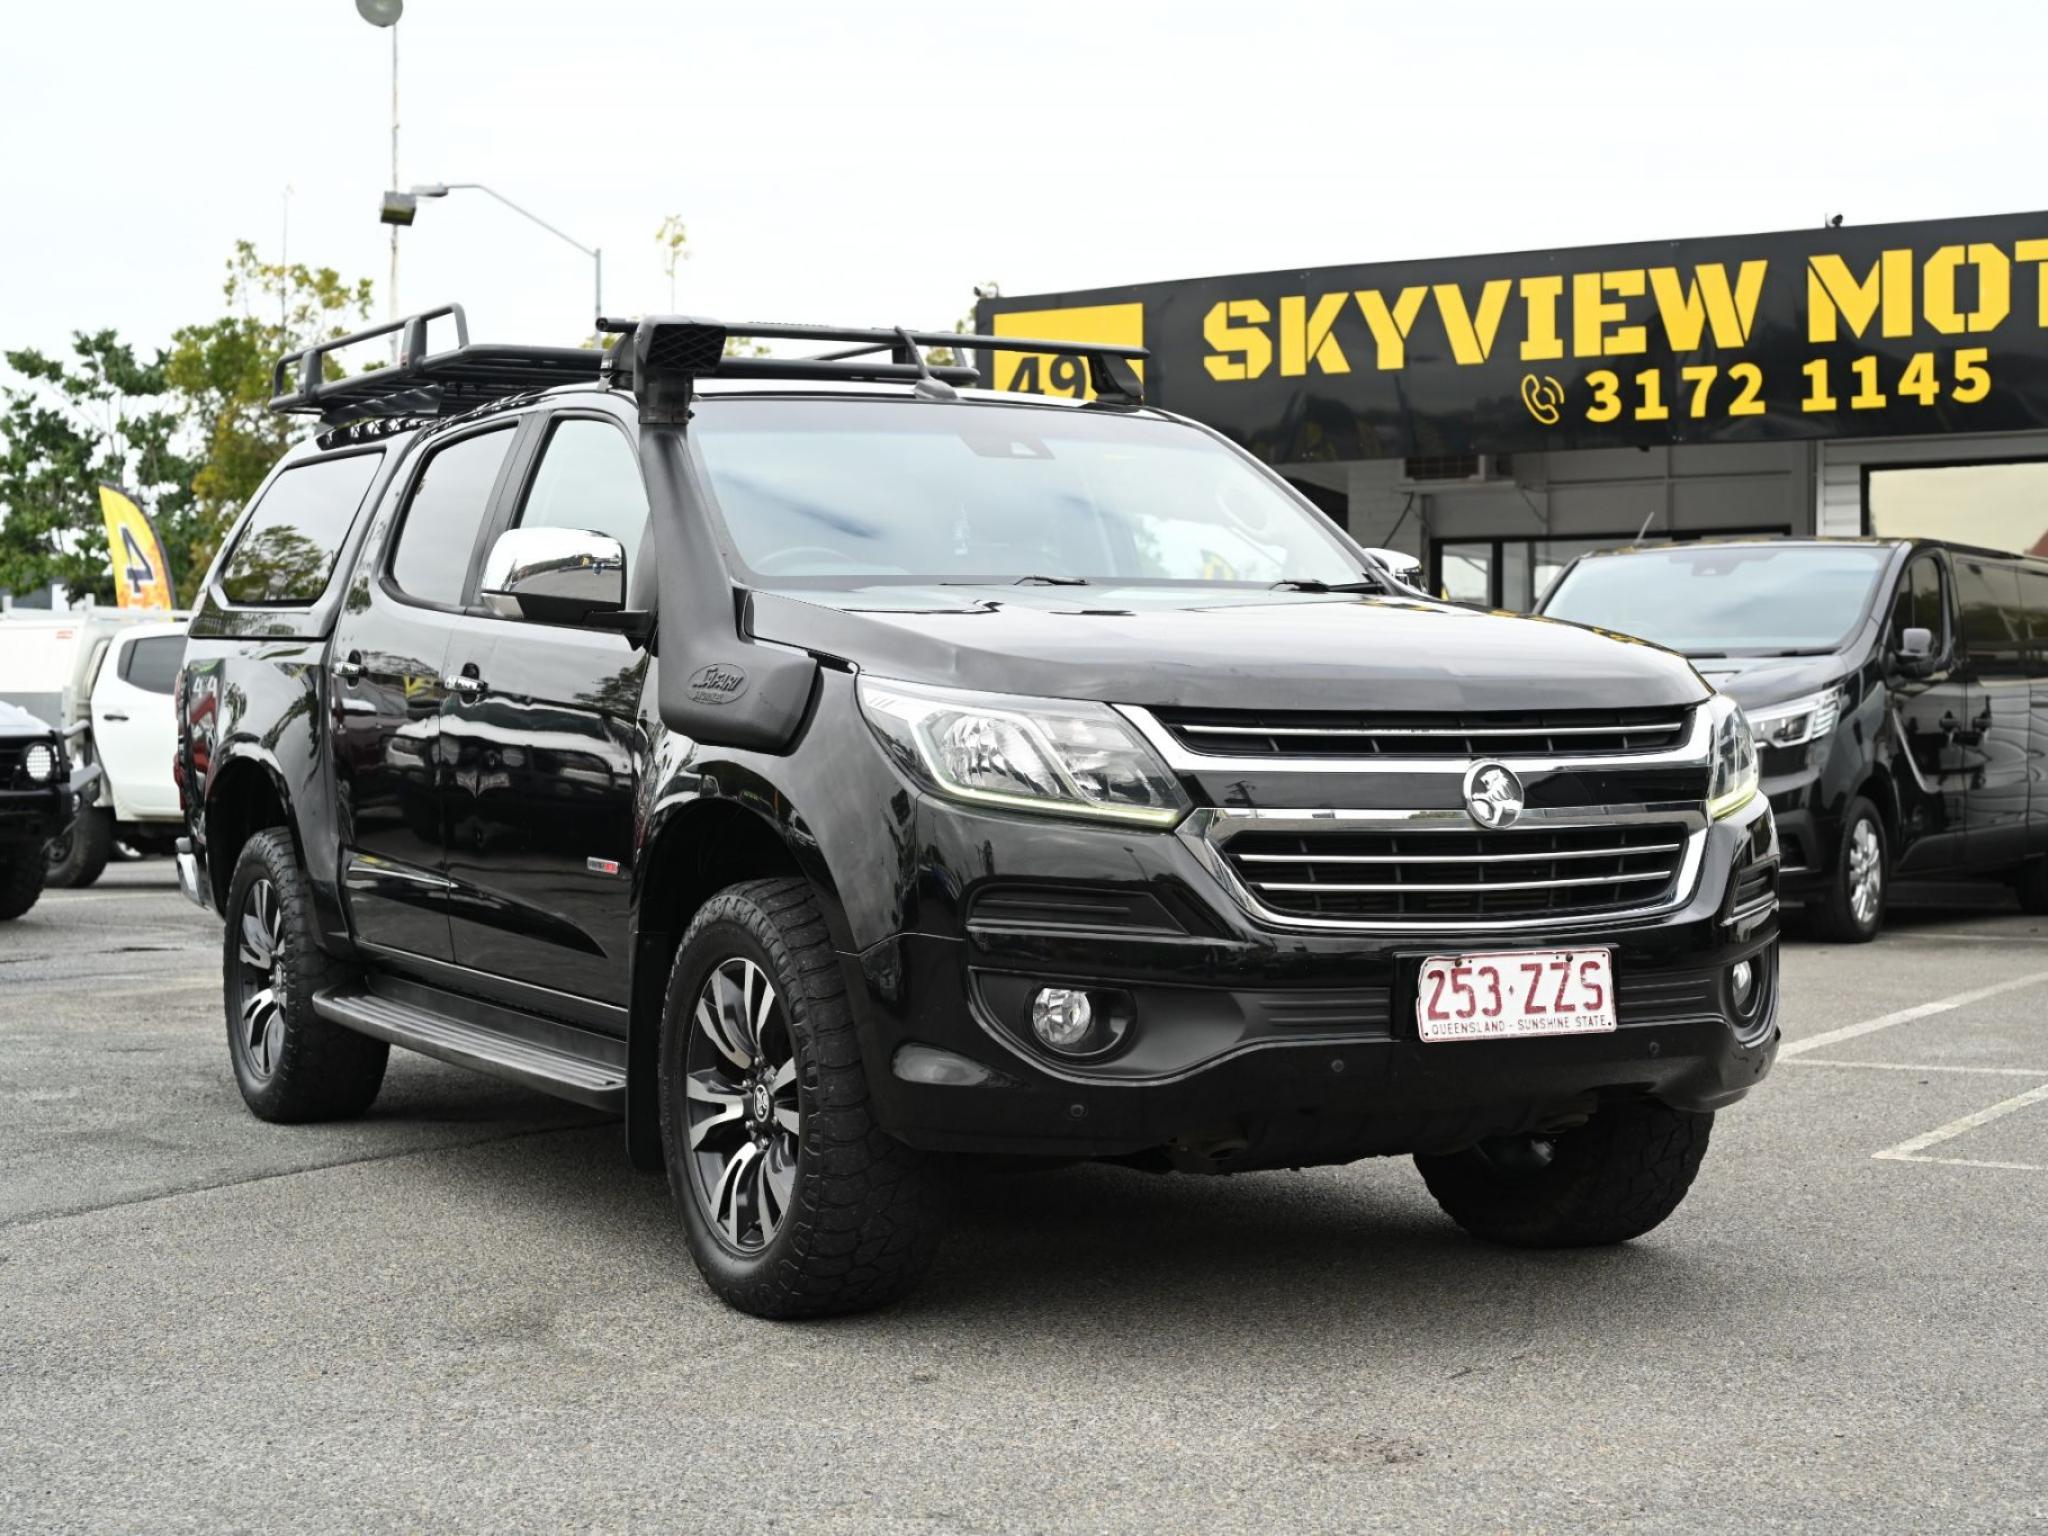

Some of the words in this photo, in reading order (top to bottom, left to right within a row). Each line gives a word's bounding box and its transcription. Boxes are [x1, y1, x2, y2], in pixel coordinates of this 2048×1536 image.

[1204, 260, 1767, 380] SKYVIEW
[1585, 363, 1766, 423] 3172
[1802, 348, 1992, 412] 1145
[1431, 1020, 1505, 1035] QUEENSLAND
[1517, 1017, 1570, 1031] SUNSHINE
[1576, 1014, 1606, 1027] STATE
